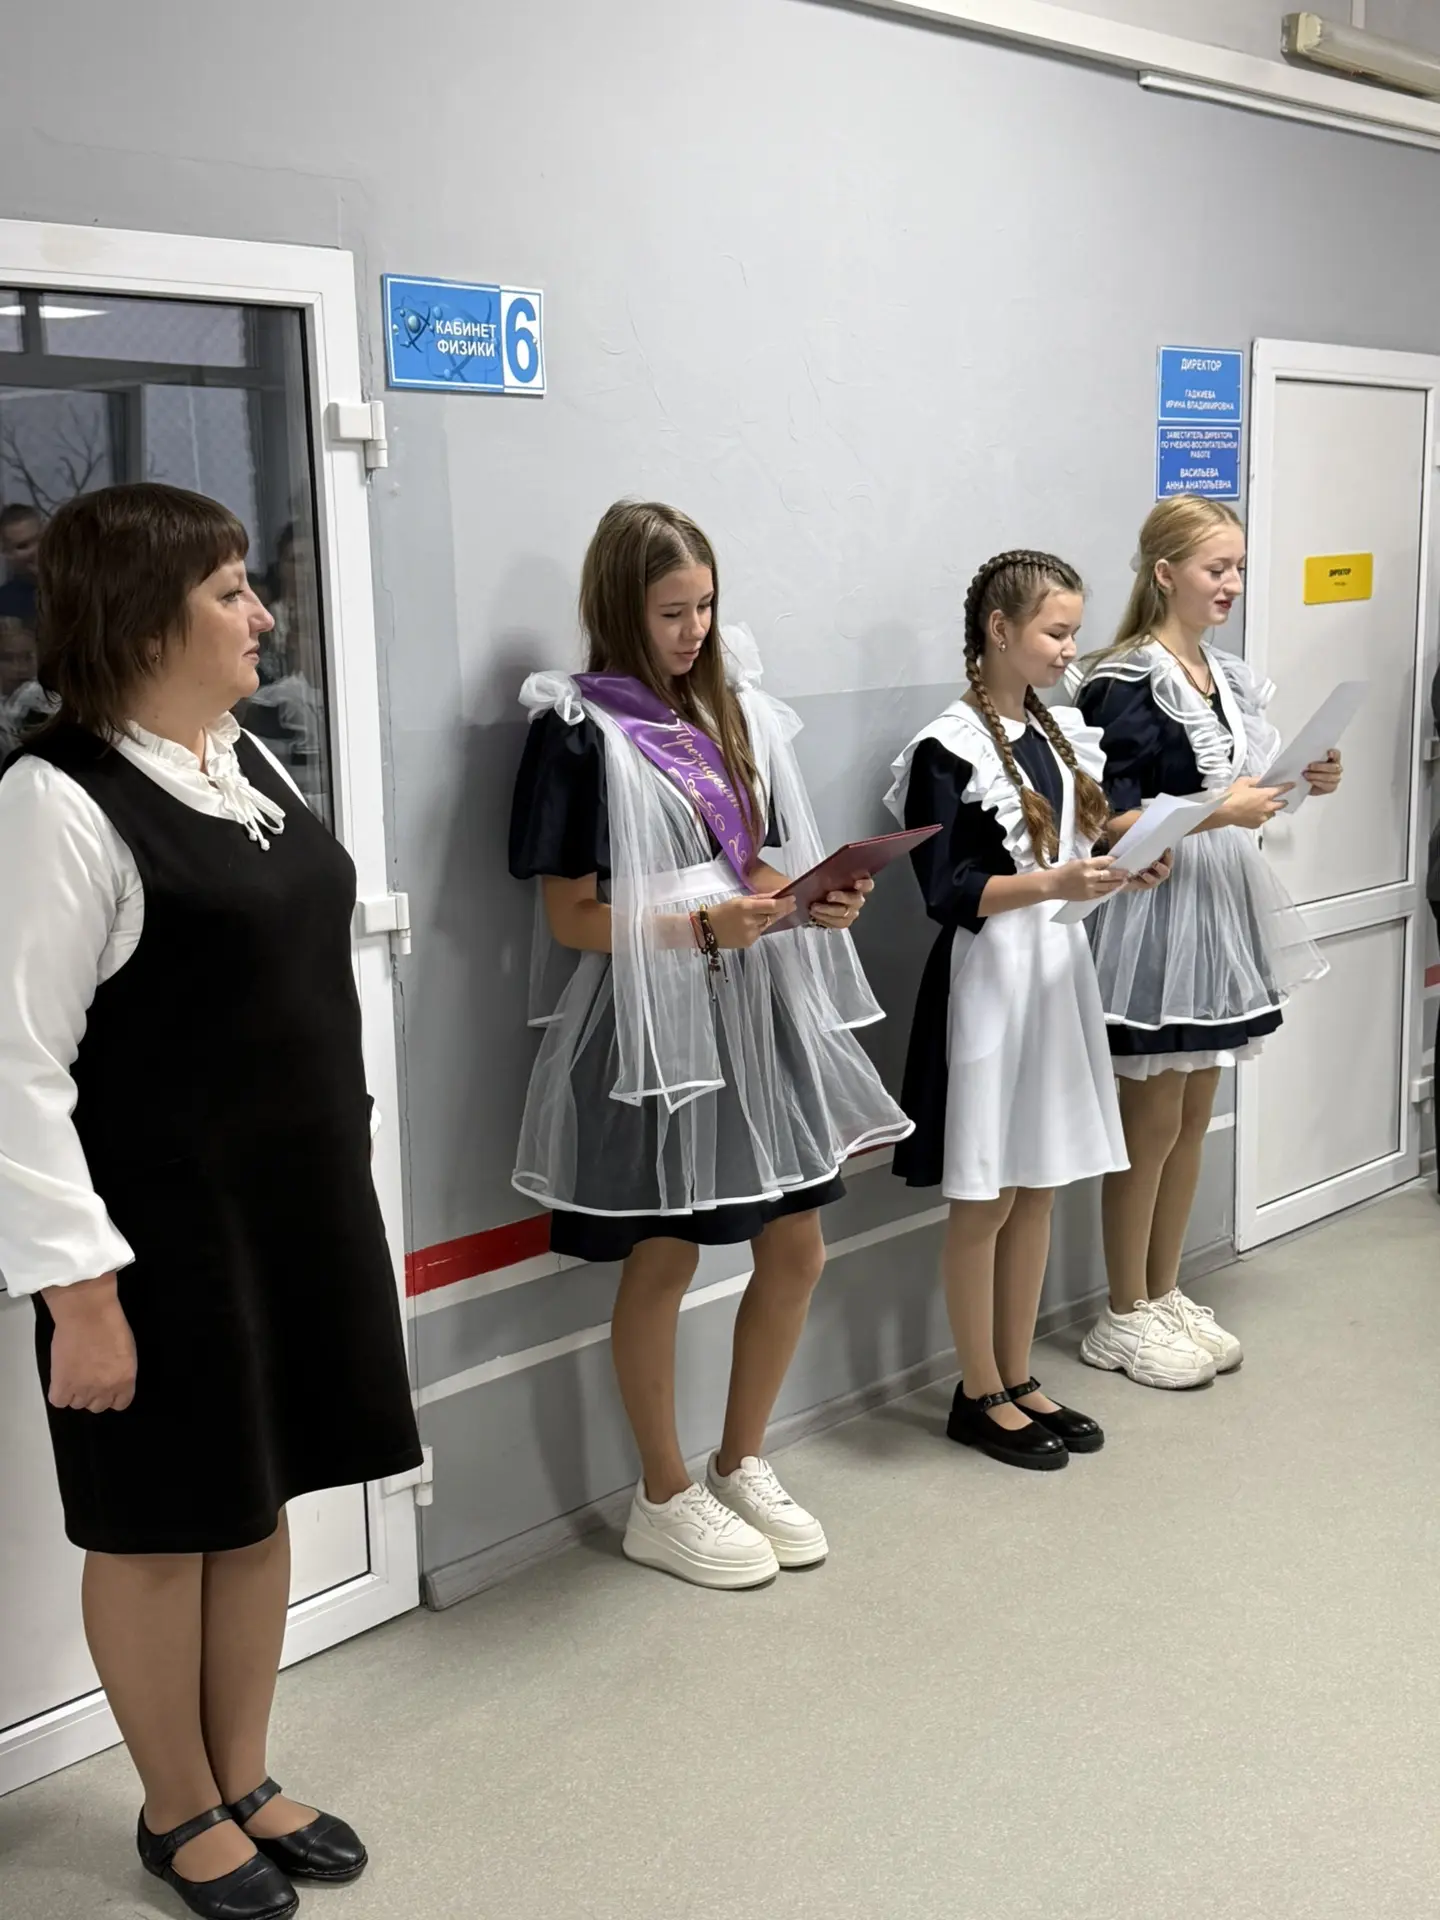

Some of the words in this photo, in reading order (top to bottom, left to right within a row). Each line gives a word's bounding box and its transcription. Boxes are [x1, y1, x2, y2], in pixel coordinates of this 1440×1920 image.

[435, 319, 497, 338] КАБИНЕТ
[506, 297, 539, 384] 6
[437, 339, 496, 358] ФИЗИКИ
[1181, 358, 1222, 372] ДИРЕКТОР
[1165, 400, 1186, 409] ИРИНА
[1180, 467, 1219, 478] ВАСИЛЬЕВА
[1165, 480, 1184, 490] АННА
